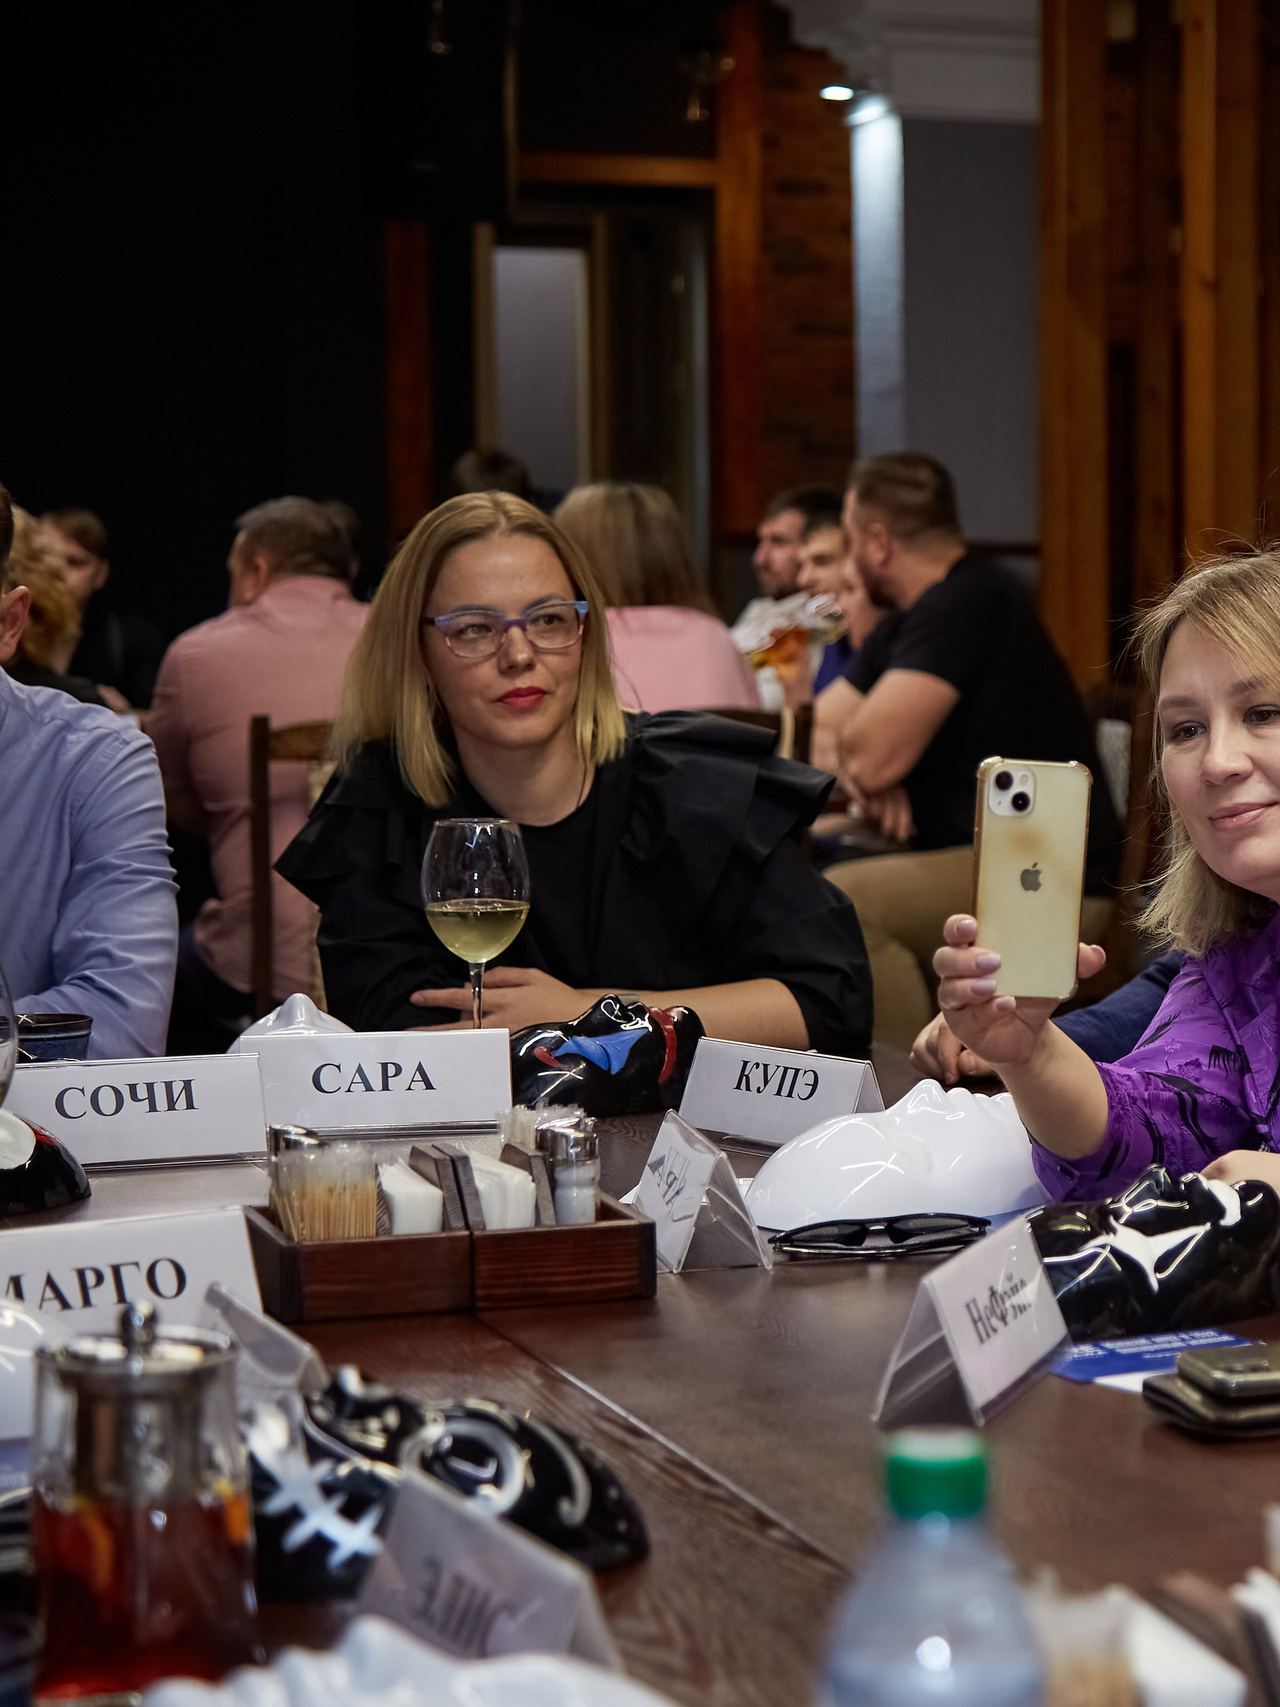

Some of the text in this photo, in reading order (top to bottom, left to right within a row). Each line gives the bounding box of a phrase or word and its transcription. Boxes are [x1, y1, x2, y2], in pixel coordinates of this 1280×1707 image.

[312, 1061, 437, 1094] САРА
[733, 1060, 819, 1101] КУПЭ
[55, 1078, 199, 1120] СОЧИ
